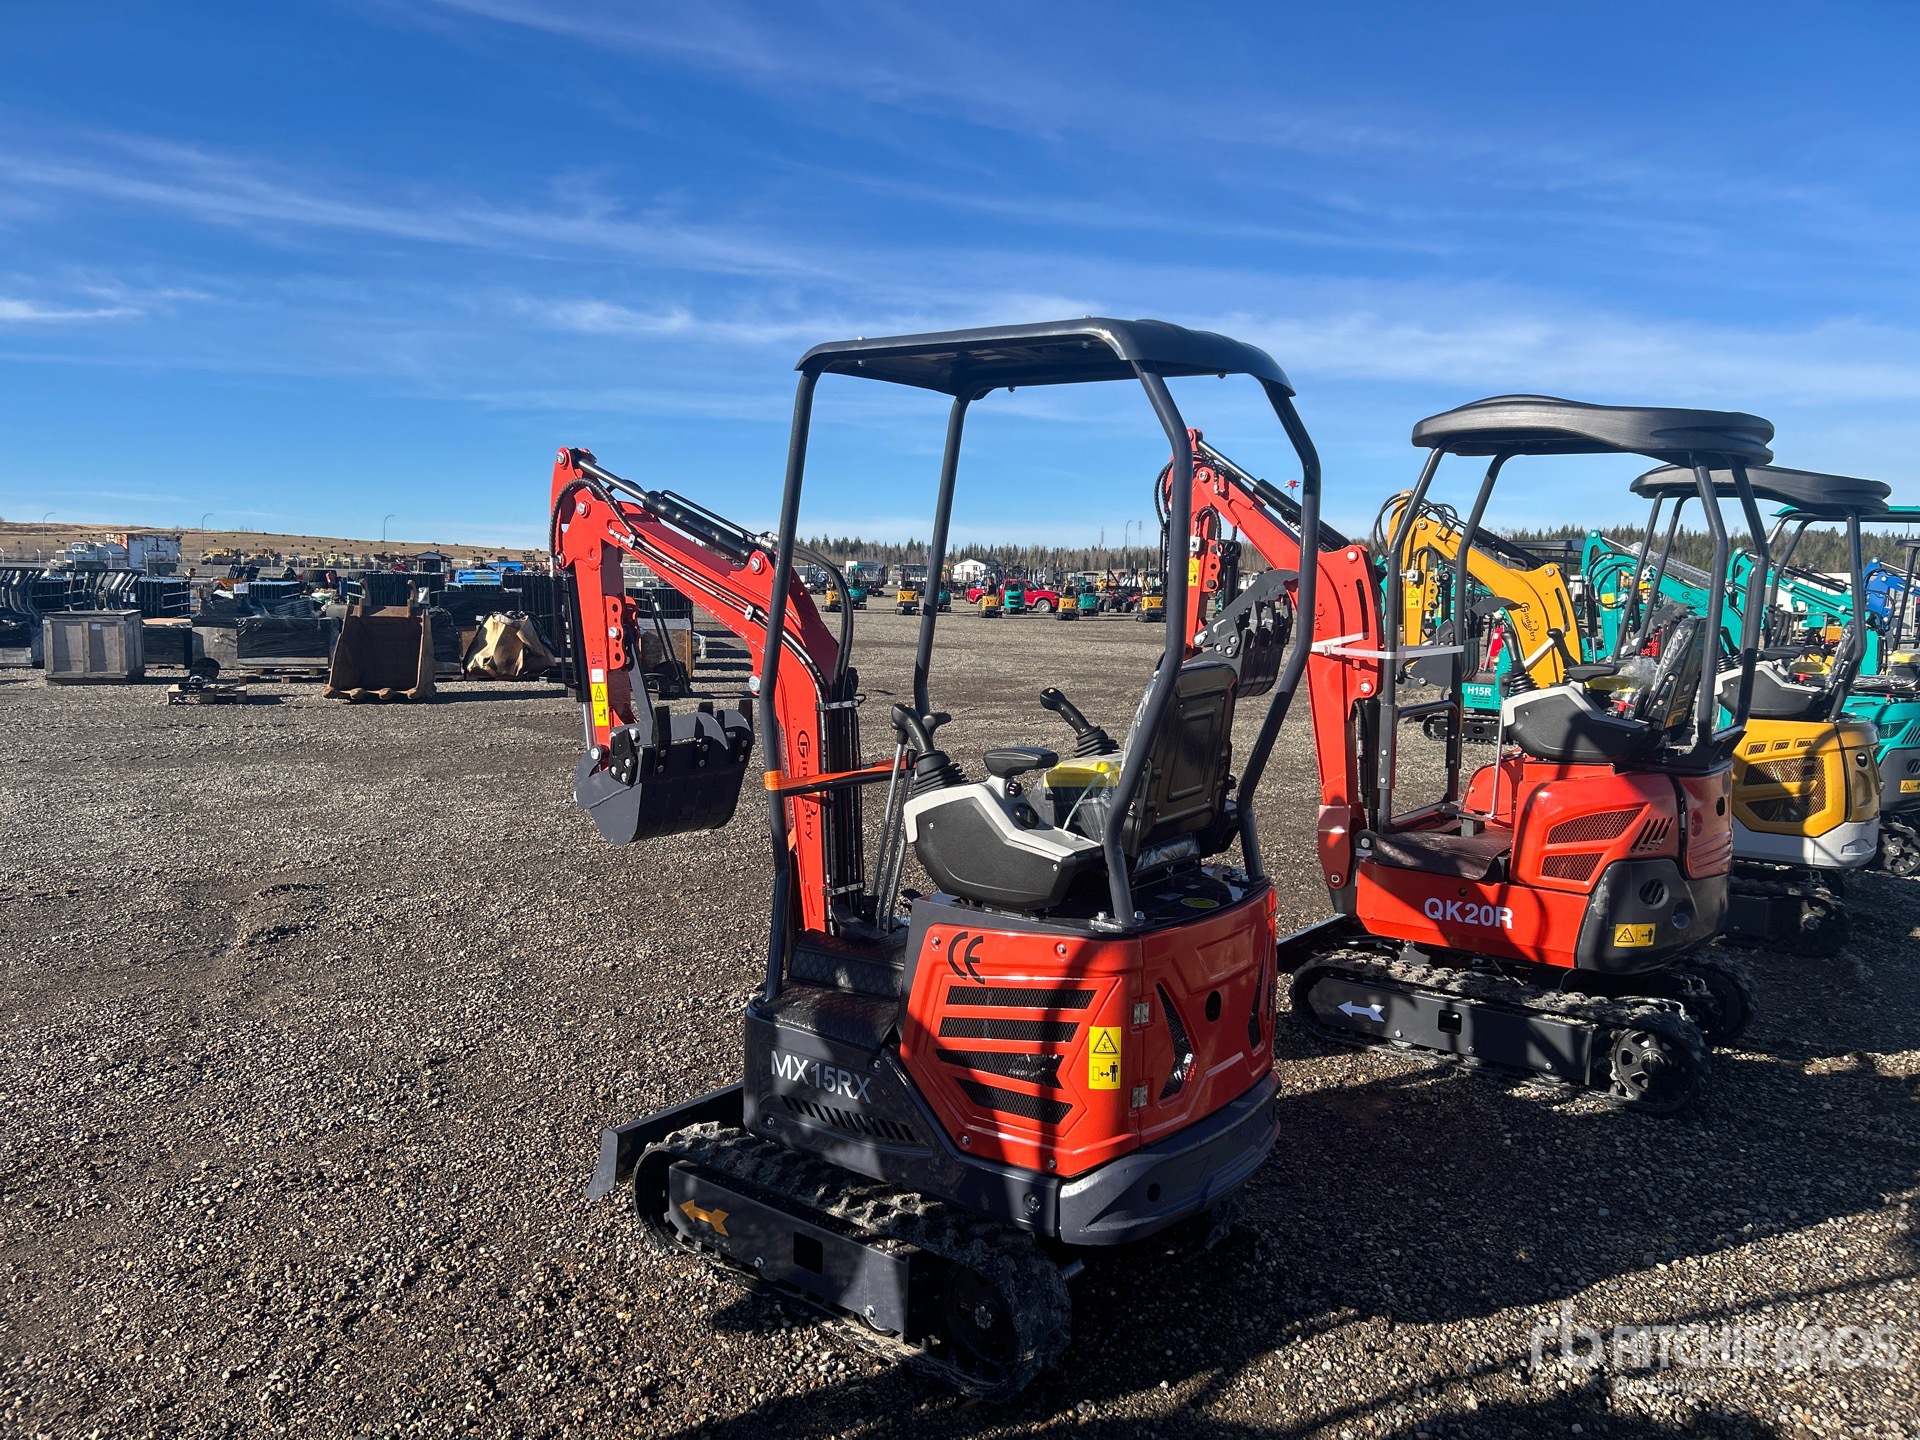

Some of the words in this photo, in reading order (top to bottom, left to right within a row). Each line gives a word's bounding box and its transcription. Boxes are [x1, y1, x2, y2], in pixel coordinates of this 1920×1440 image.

[1467, 686, 1492, 696] H15R
[1424, 897, 1513, 929] QK20R
[948, 931, 985, 985] CE
[771, 1050, 872, 1104] MX15RX
